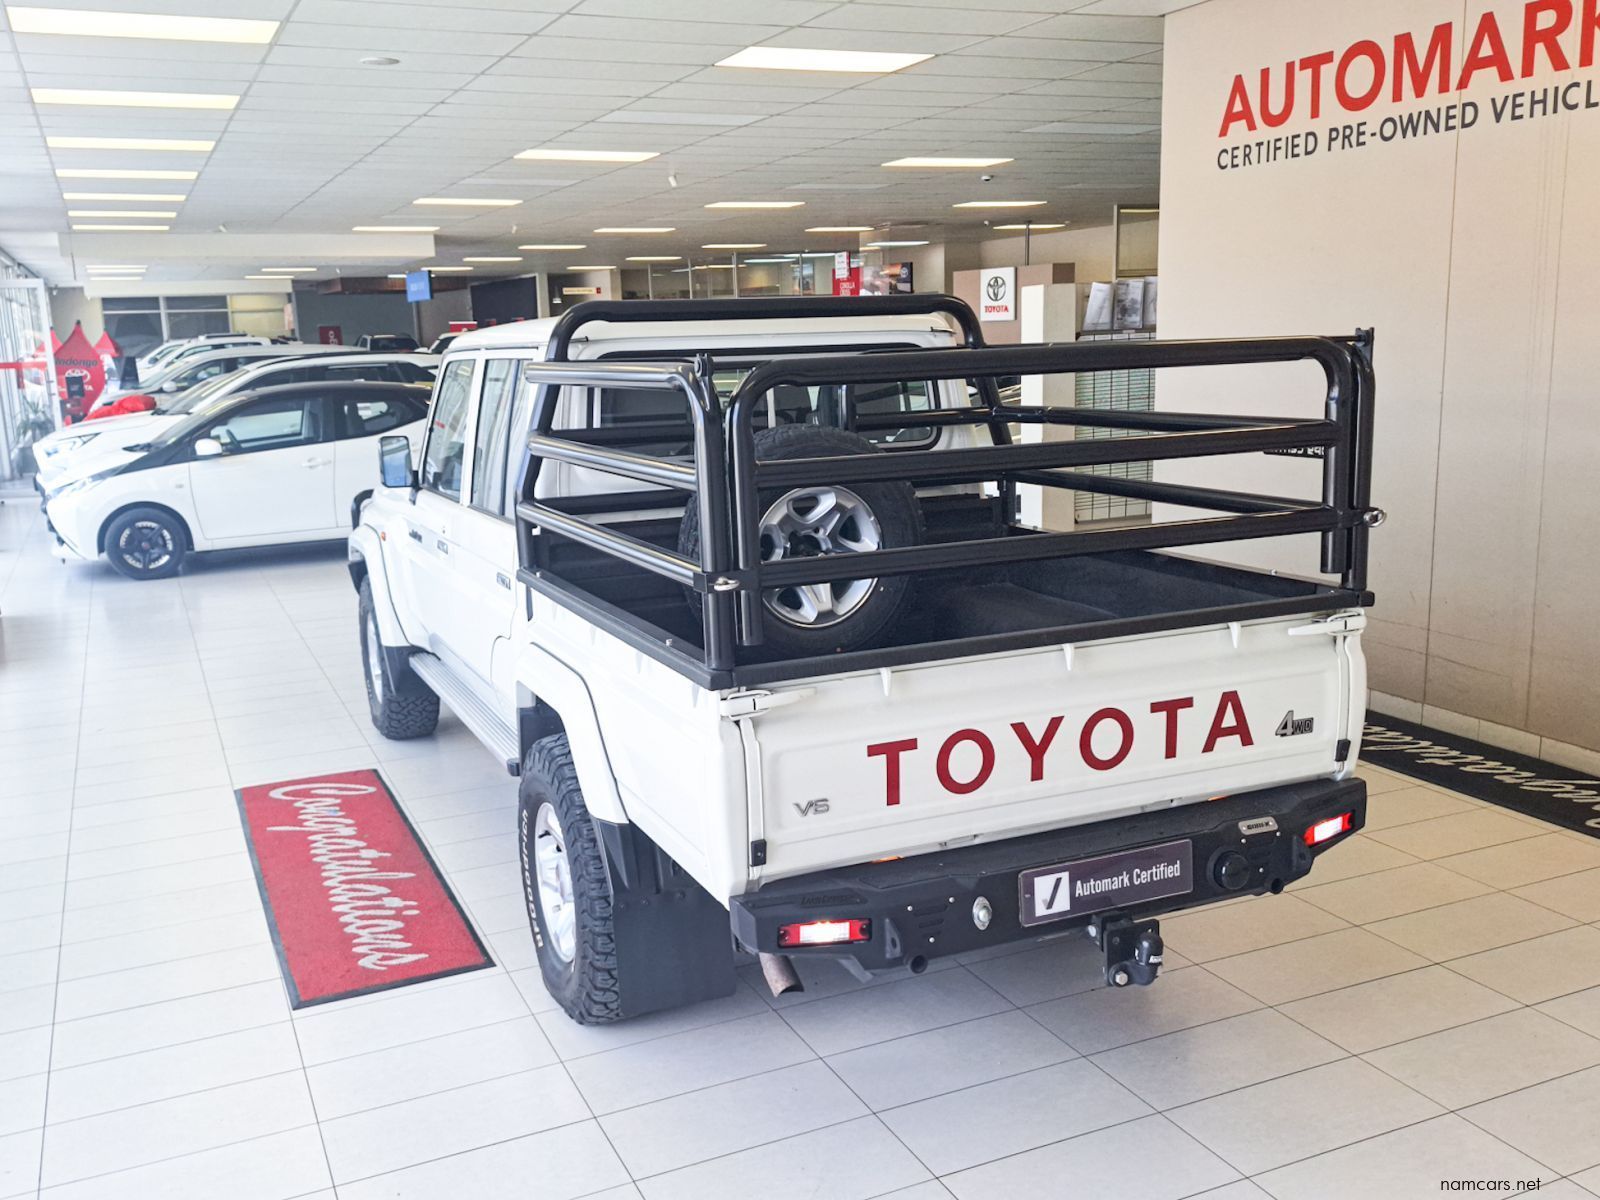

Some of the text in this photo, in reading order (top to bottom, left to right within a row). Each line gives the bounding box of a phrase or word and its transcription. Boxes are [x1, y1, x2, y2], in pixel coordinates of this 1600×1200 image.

[1217, 131, 1318, 171] CERTIFIED
[1327, 101, 1479, 152] PRE-OWNED
[984, 305, 1009, 313] TOYOTA
[866, 689, 1255, 807] TOYOTA
[1275, 709, 1314, 738] 4WD
[267, 782, 429, 971] Congratulations
[1075, 860, 1181, 898] Automark Certified
